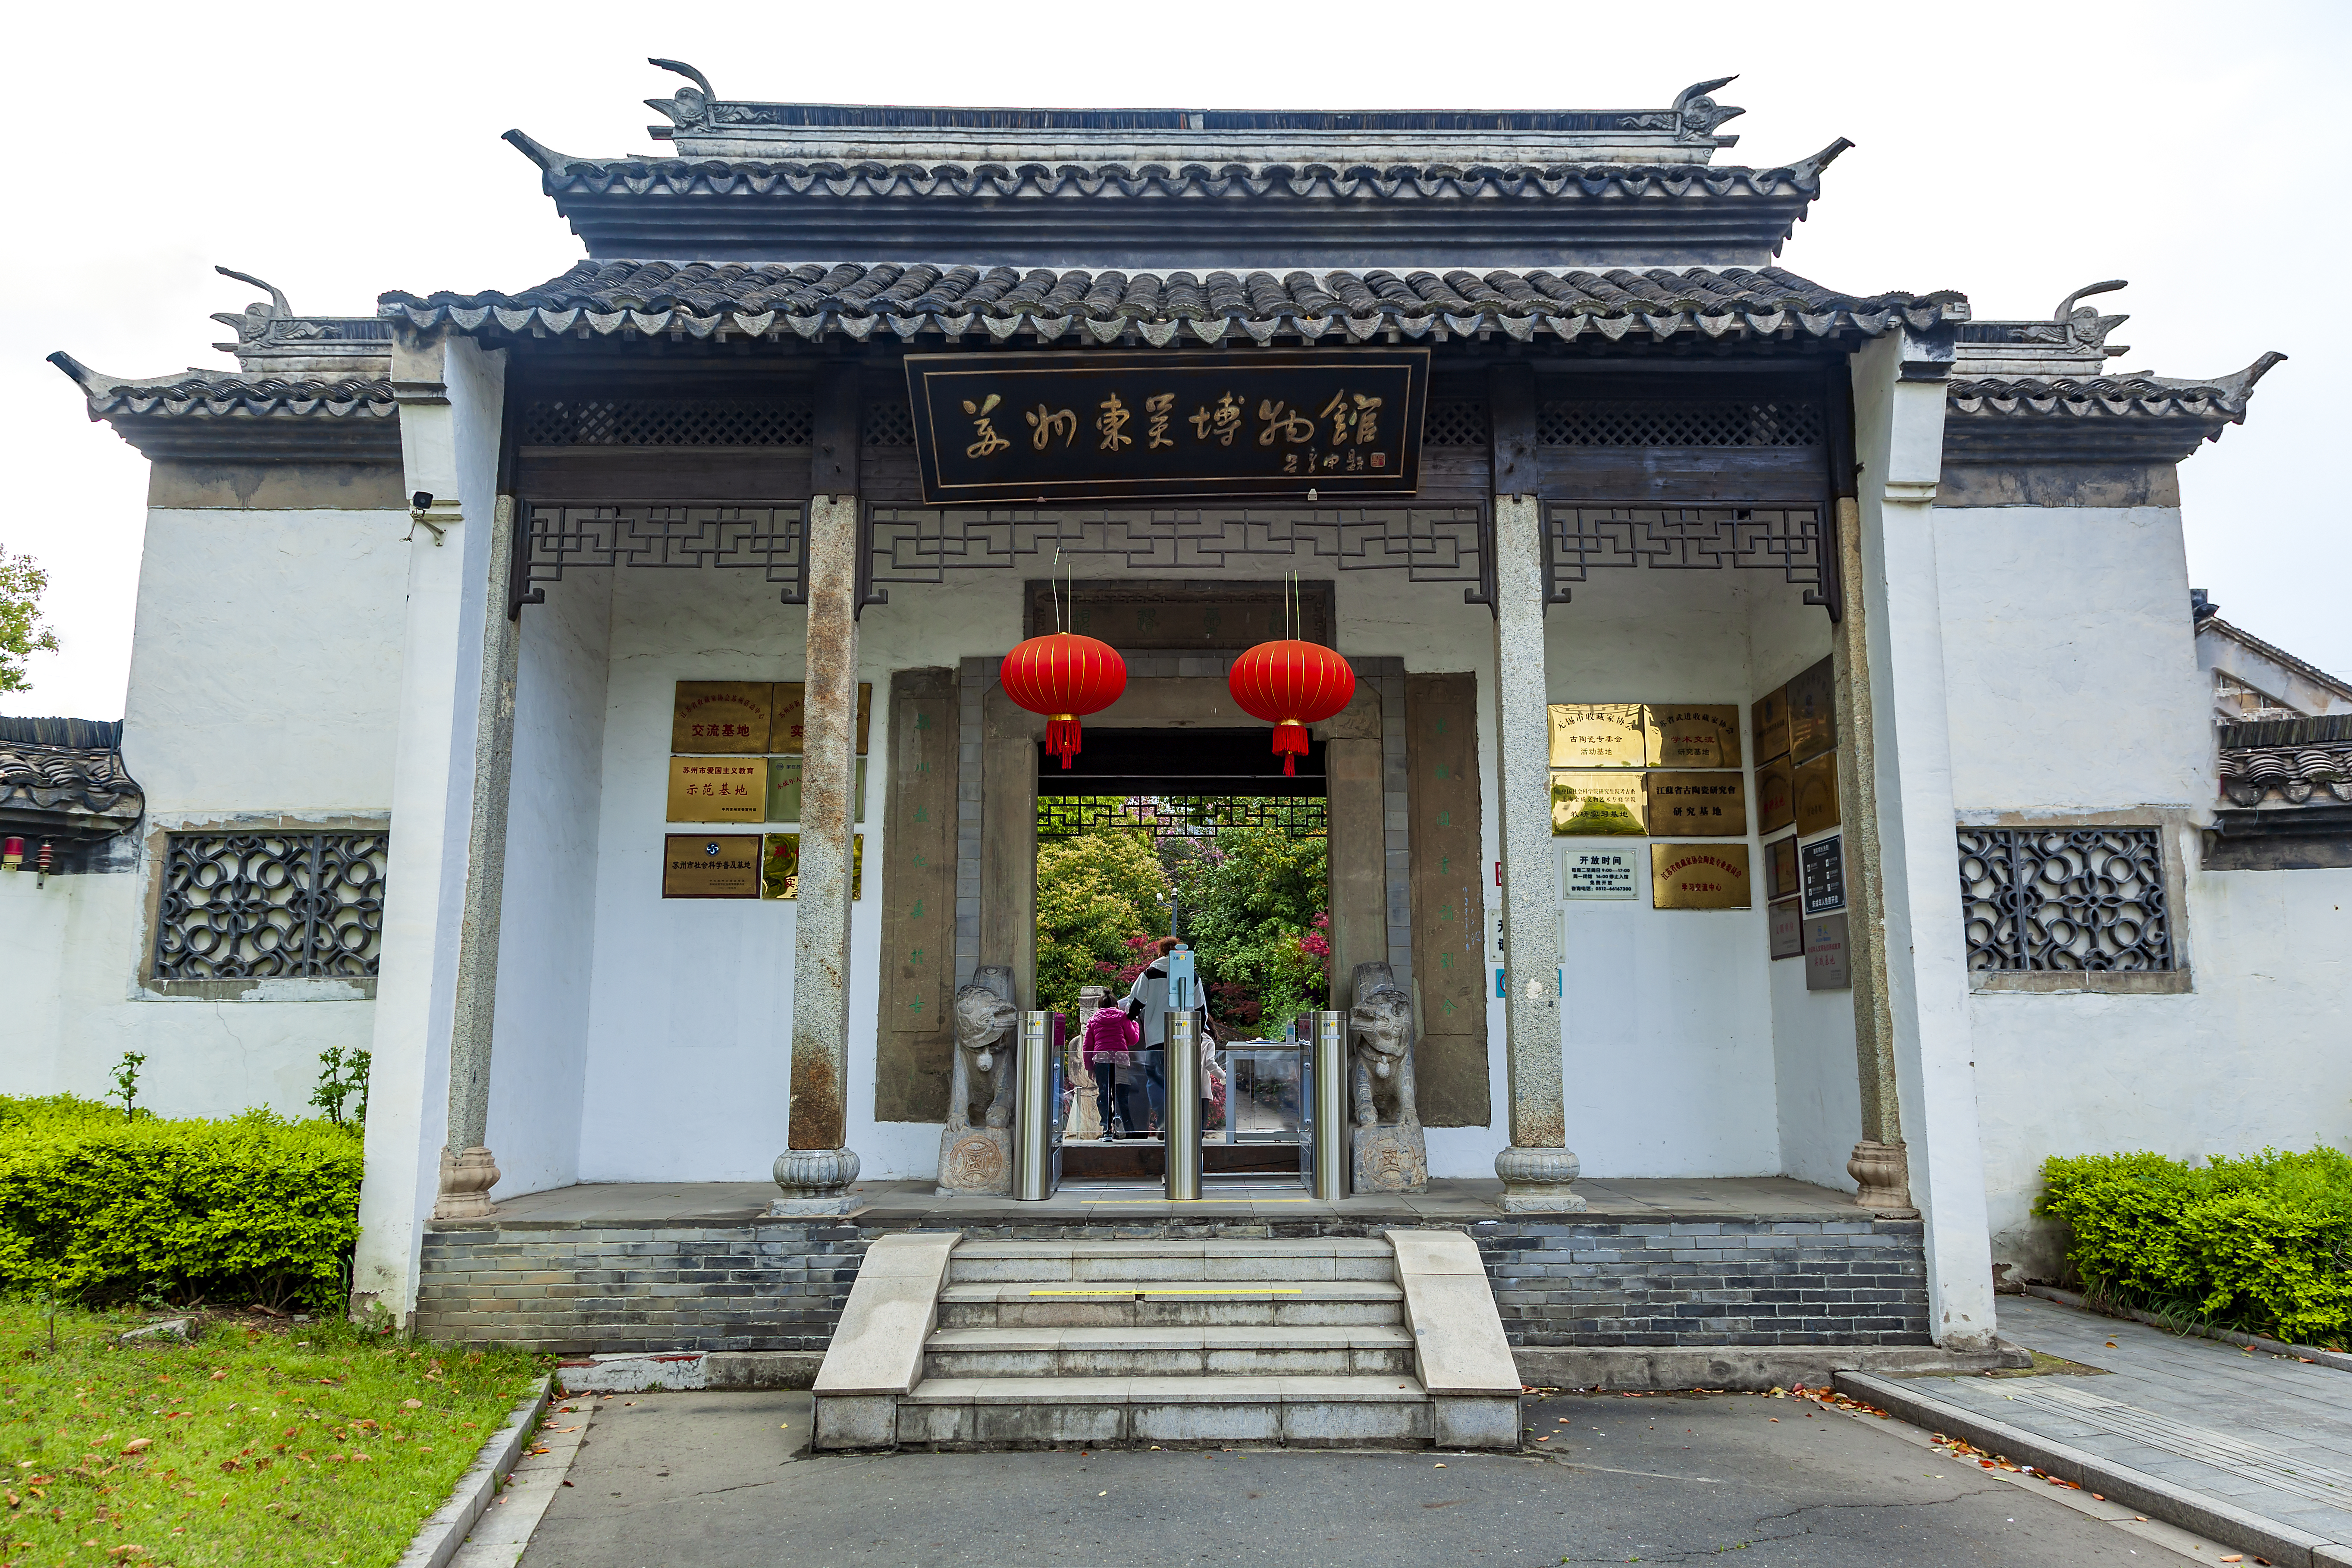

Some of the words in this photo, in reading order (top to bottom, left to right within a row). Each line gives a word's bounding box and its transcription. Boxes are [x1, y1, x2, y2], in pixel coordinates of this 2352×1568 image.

[680, 694, 765, 719] 江苏省收藏家协会苏州活动中心
[1557, 712, 1634, 731] 无锡市收藏家协会
[1652, 712, 1734, 735] 江苏省武进收藏家协会
[692, 724, 750, 737] 交流基地
[683, 766, 754, 775] 苏州市爱国主义教育
[687, 782, 748, 796] 示范基地
[1673, 806, 1722, 816] 研究基地
[672, 861, 751, 869] 苏州市社会科学普及基地
[1580, 856, 1621, 865] 开放时间
[1660, 855, 1742, 881] 江苏省收藏家协会陶瓷专业委员会
[1682, 883, 1722, 891] 学习交流中心
